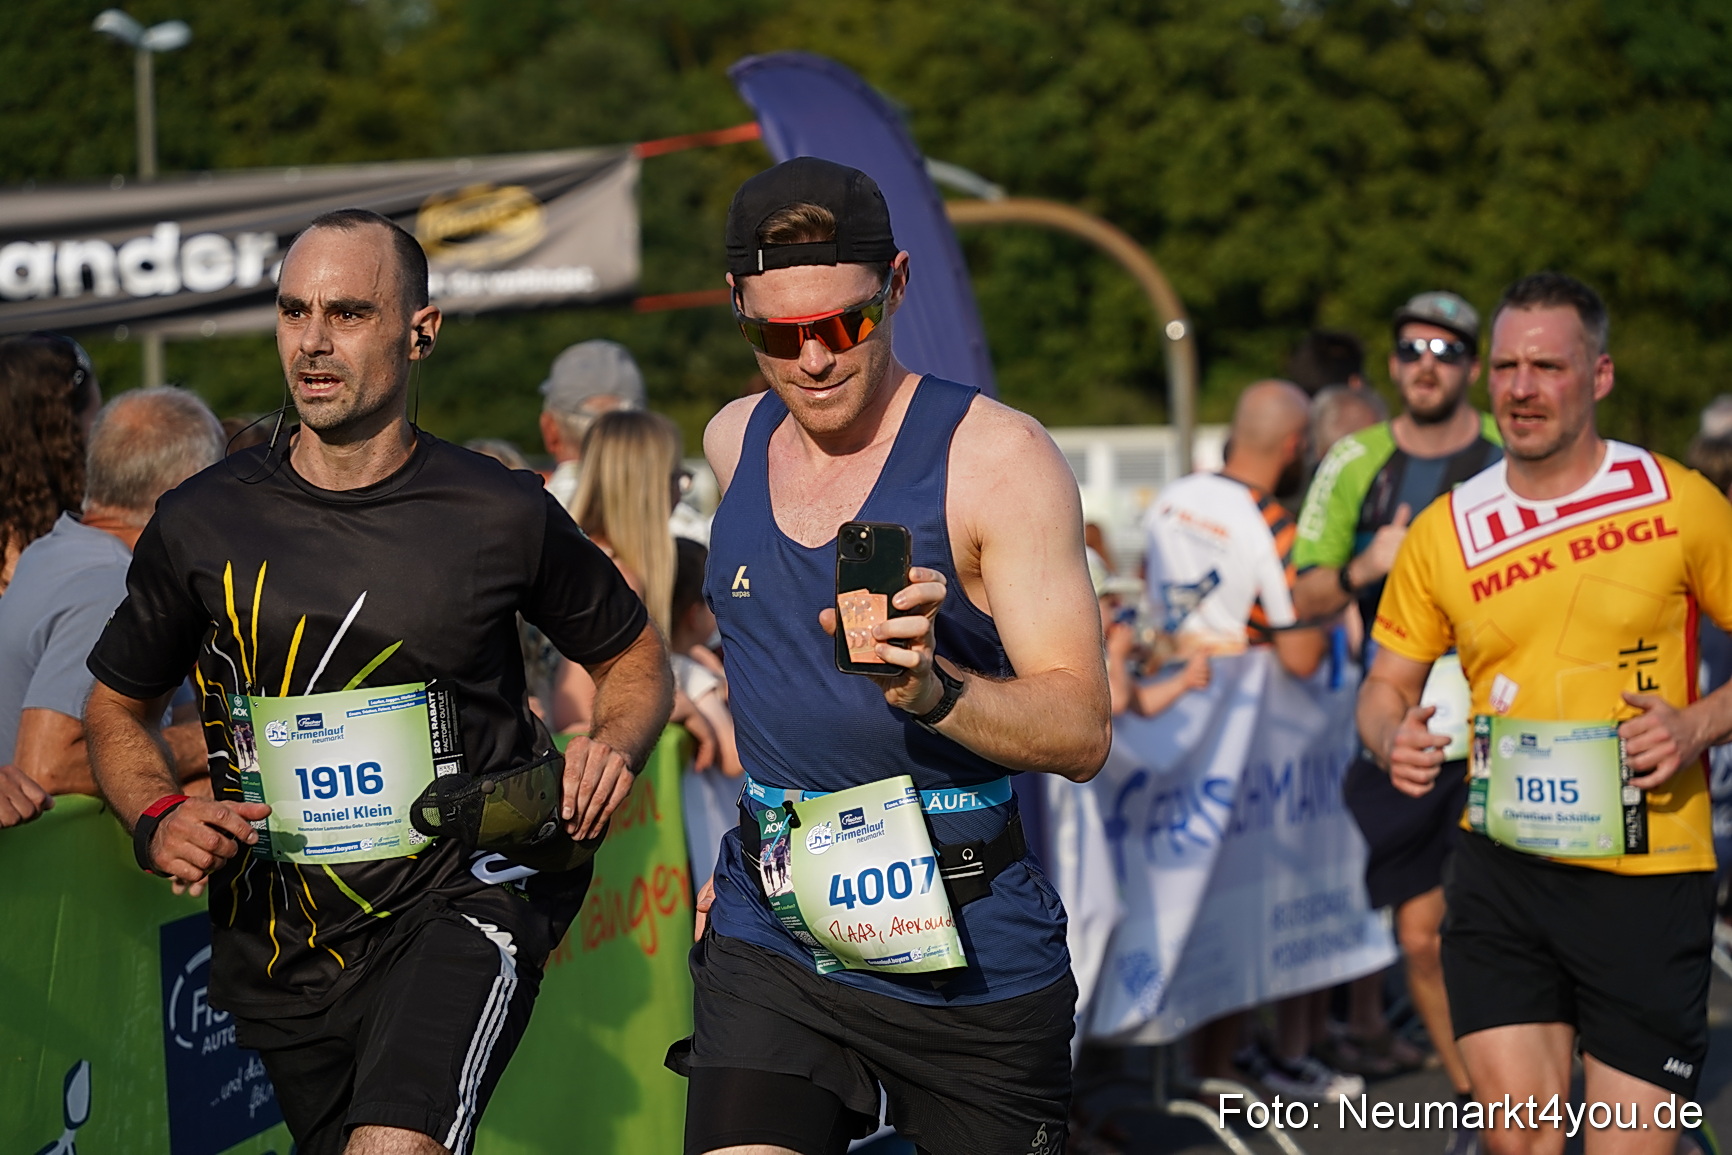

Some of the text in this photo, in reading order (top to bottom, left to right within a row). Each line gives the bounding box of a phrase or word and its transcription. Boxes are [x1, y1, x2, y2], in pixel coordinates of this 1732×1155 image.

[1470, 517, 1678, 604] MAX BÖGL
[232, 707, 249, 718] AOK
[438, 691, 447, 719] OUTLET
[291, 725, 345, 741] Firmenlauf
[428, 691, 441, 754] 20 % RABATT
[440, 719, 449, 752] FACTORY
[312, 734, 345, 744] neumarkt
[295, 761, 384, 800] 1916
[1516, 776, 1579, 804] 1815
[303, 803, 393, 823] Daniel Klein
[764, 821, 785, 834] AOK
[835, 819, 884, 843] Firmenlauf
[856, 829, 885, 844] neumarkt
[828, 855, 936, 910] 4007
